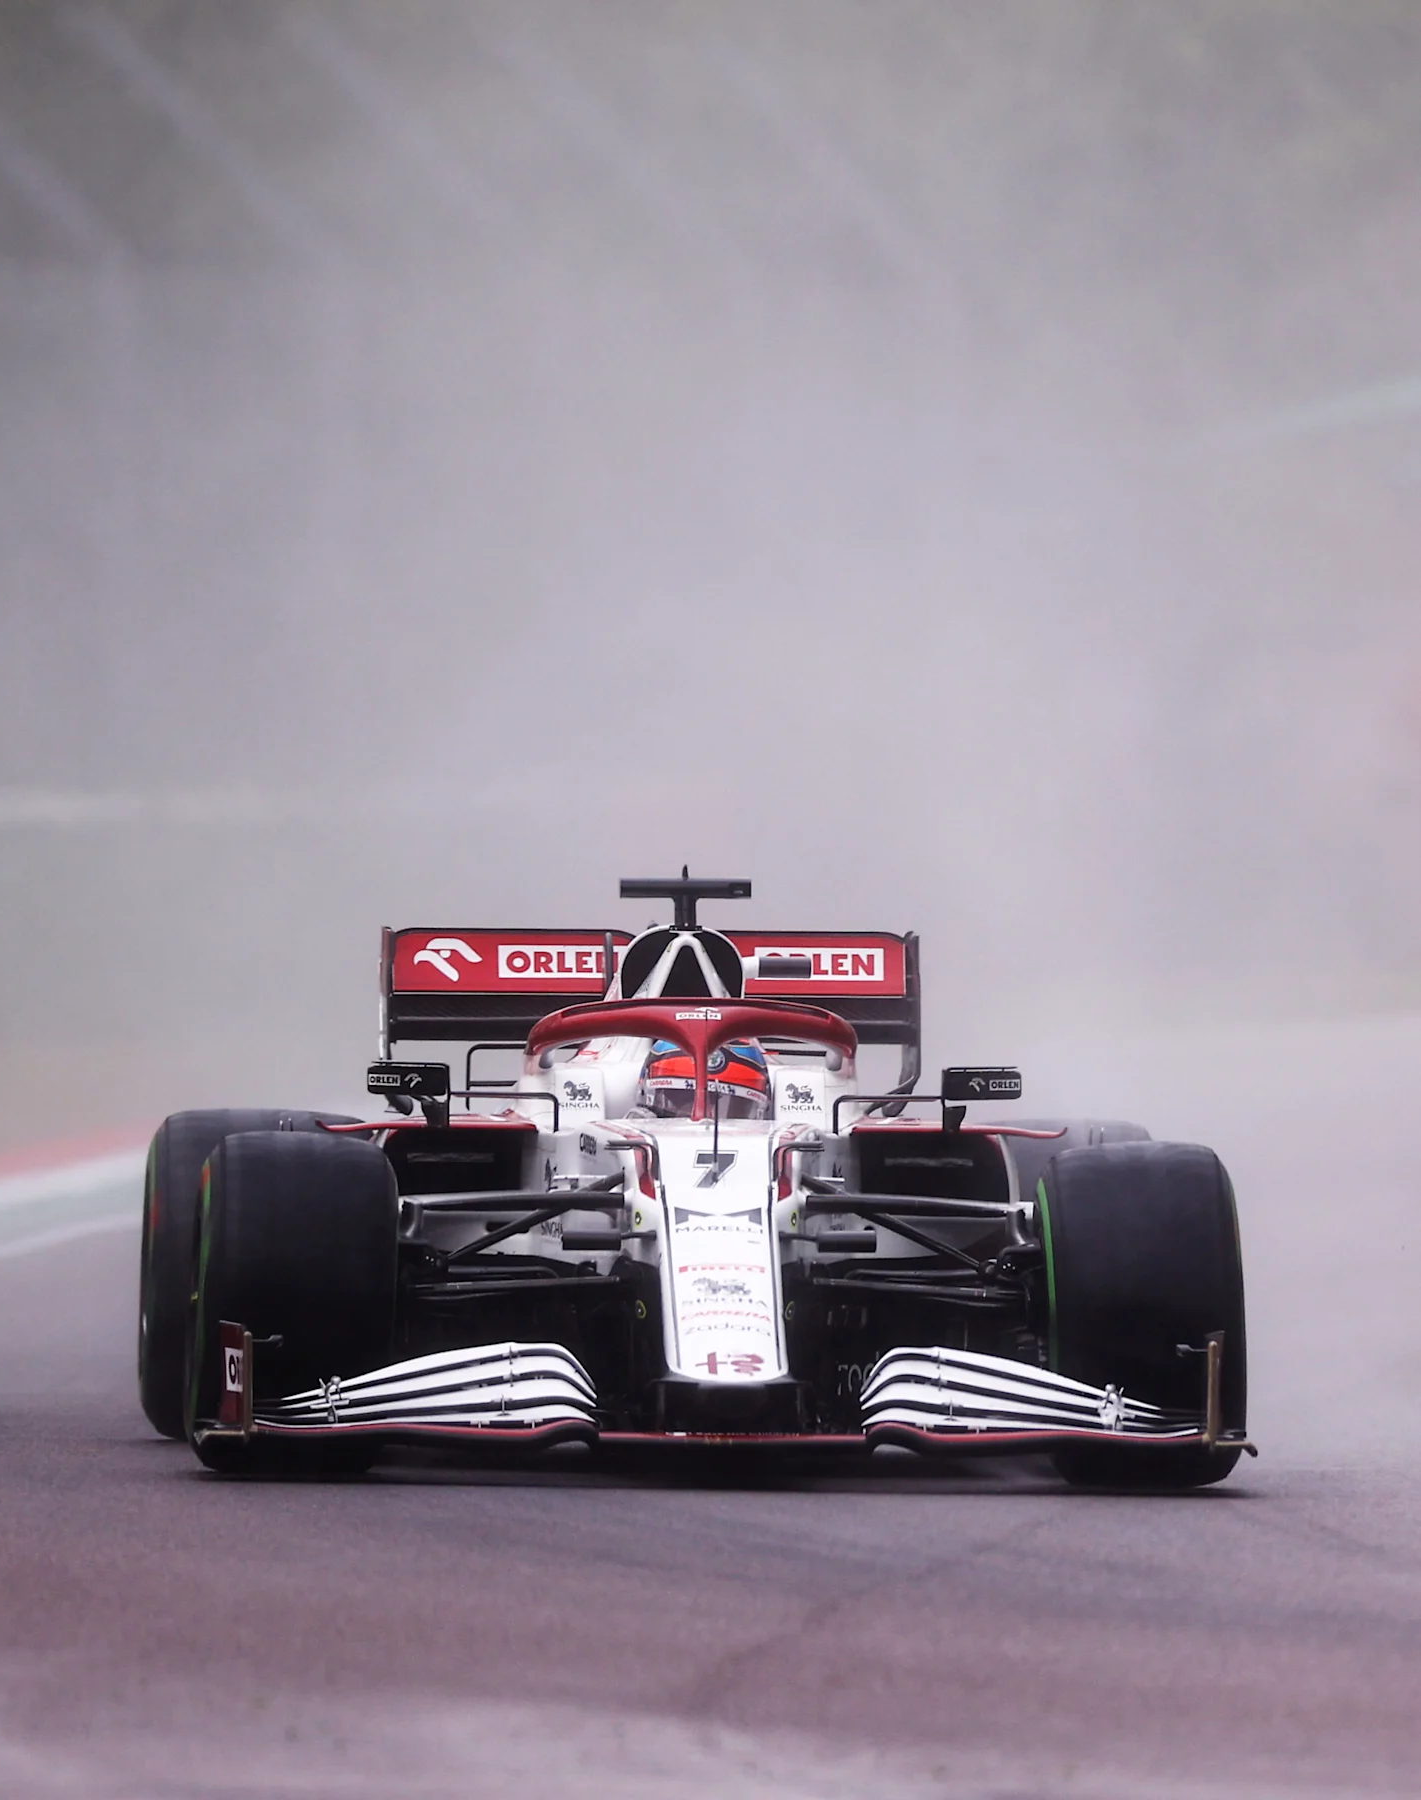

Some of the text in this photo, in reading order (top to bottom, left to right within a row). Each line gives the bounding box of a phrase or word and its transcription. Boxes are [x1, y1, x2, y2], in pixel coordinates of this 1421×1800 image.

[506, 951, 619, 973] ORLEN
[369, 1075, 400, 1085] ORLEN
[991, 1080, 1019, 1089] ORLEN
[693, 1150, 739, 1188] 7
[675, 1225, 763, 1234] MARELLI
